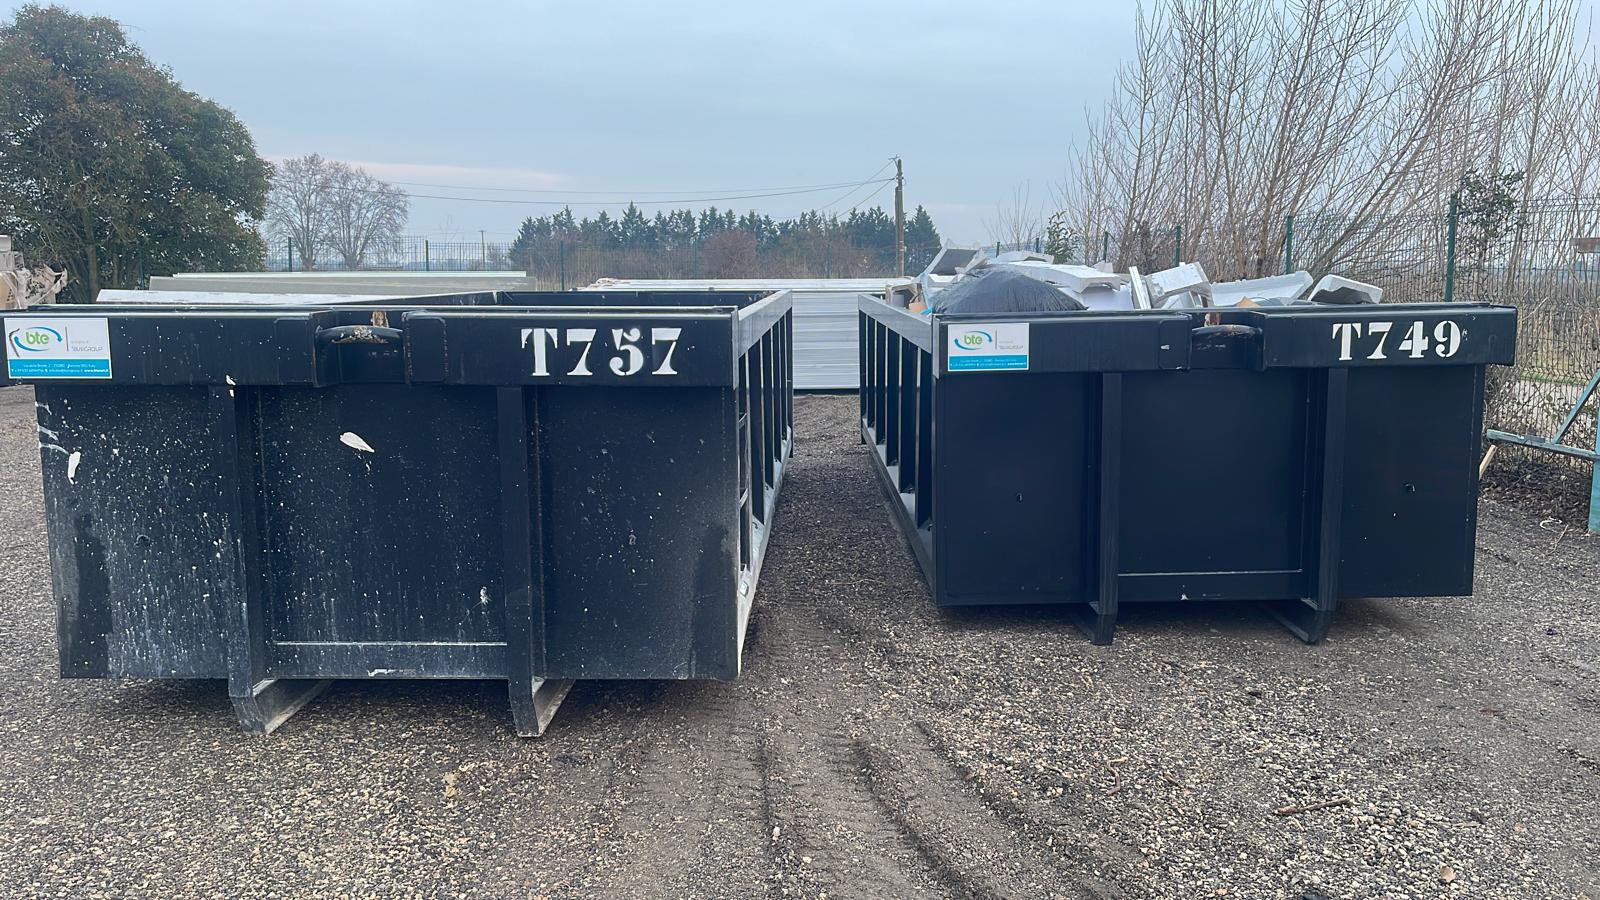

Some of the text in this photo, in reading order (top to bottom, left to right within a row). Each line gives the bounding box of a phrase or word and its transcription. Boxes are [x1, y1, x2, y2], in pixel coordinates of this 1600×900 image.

[25, 331, 50, 345] bte
[521, 327, 682, 376] T757
[964, 334, 983, 345] bte
[1332, 320, 1461, 361] T749
